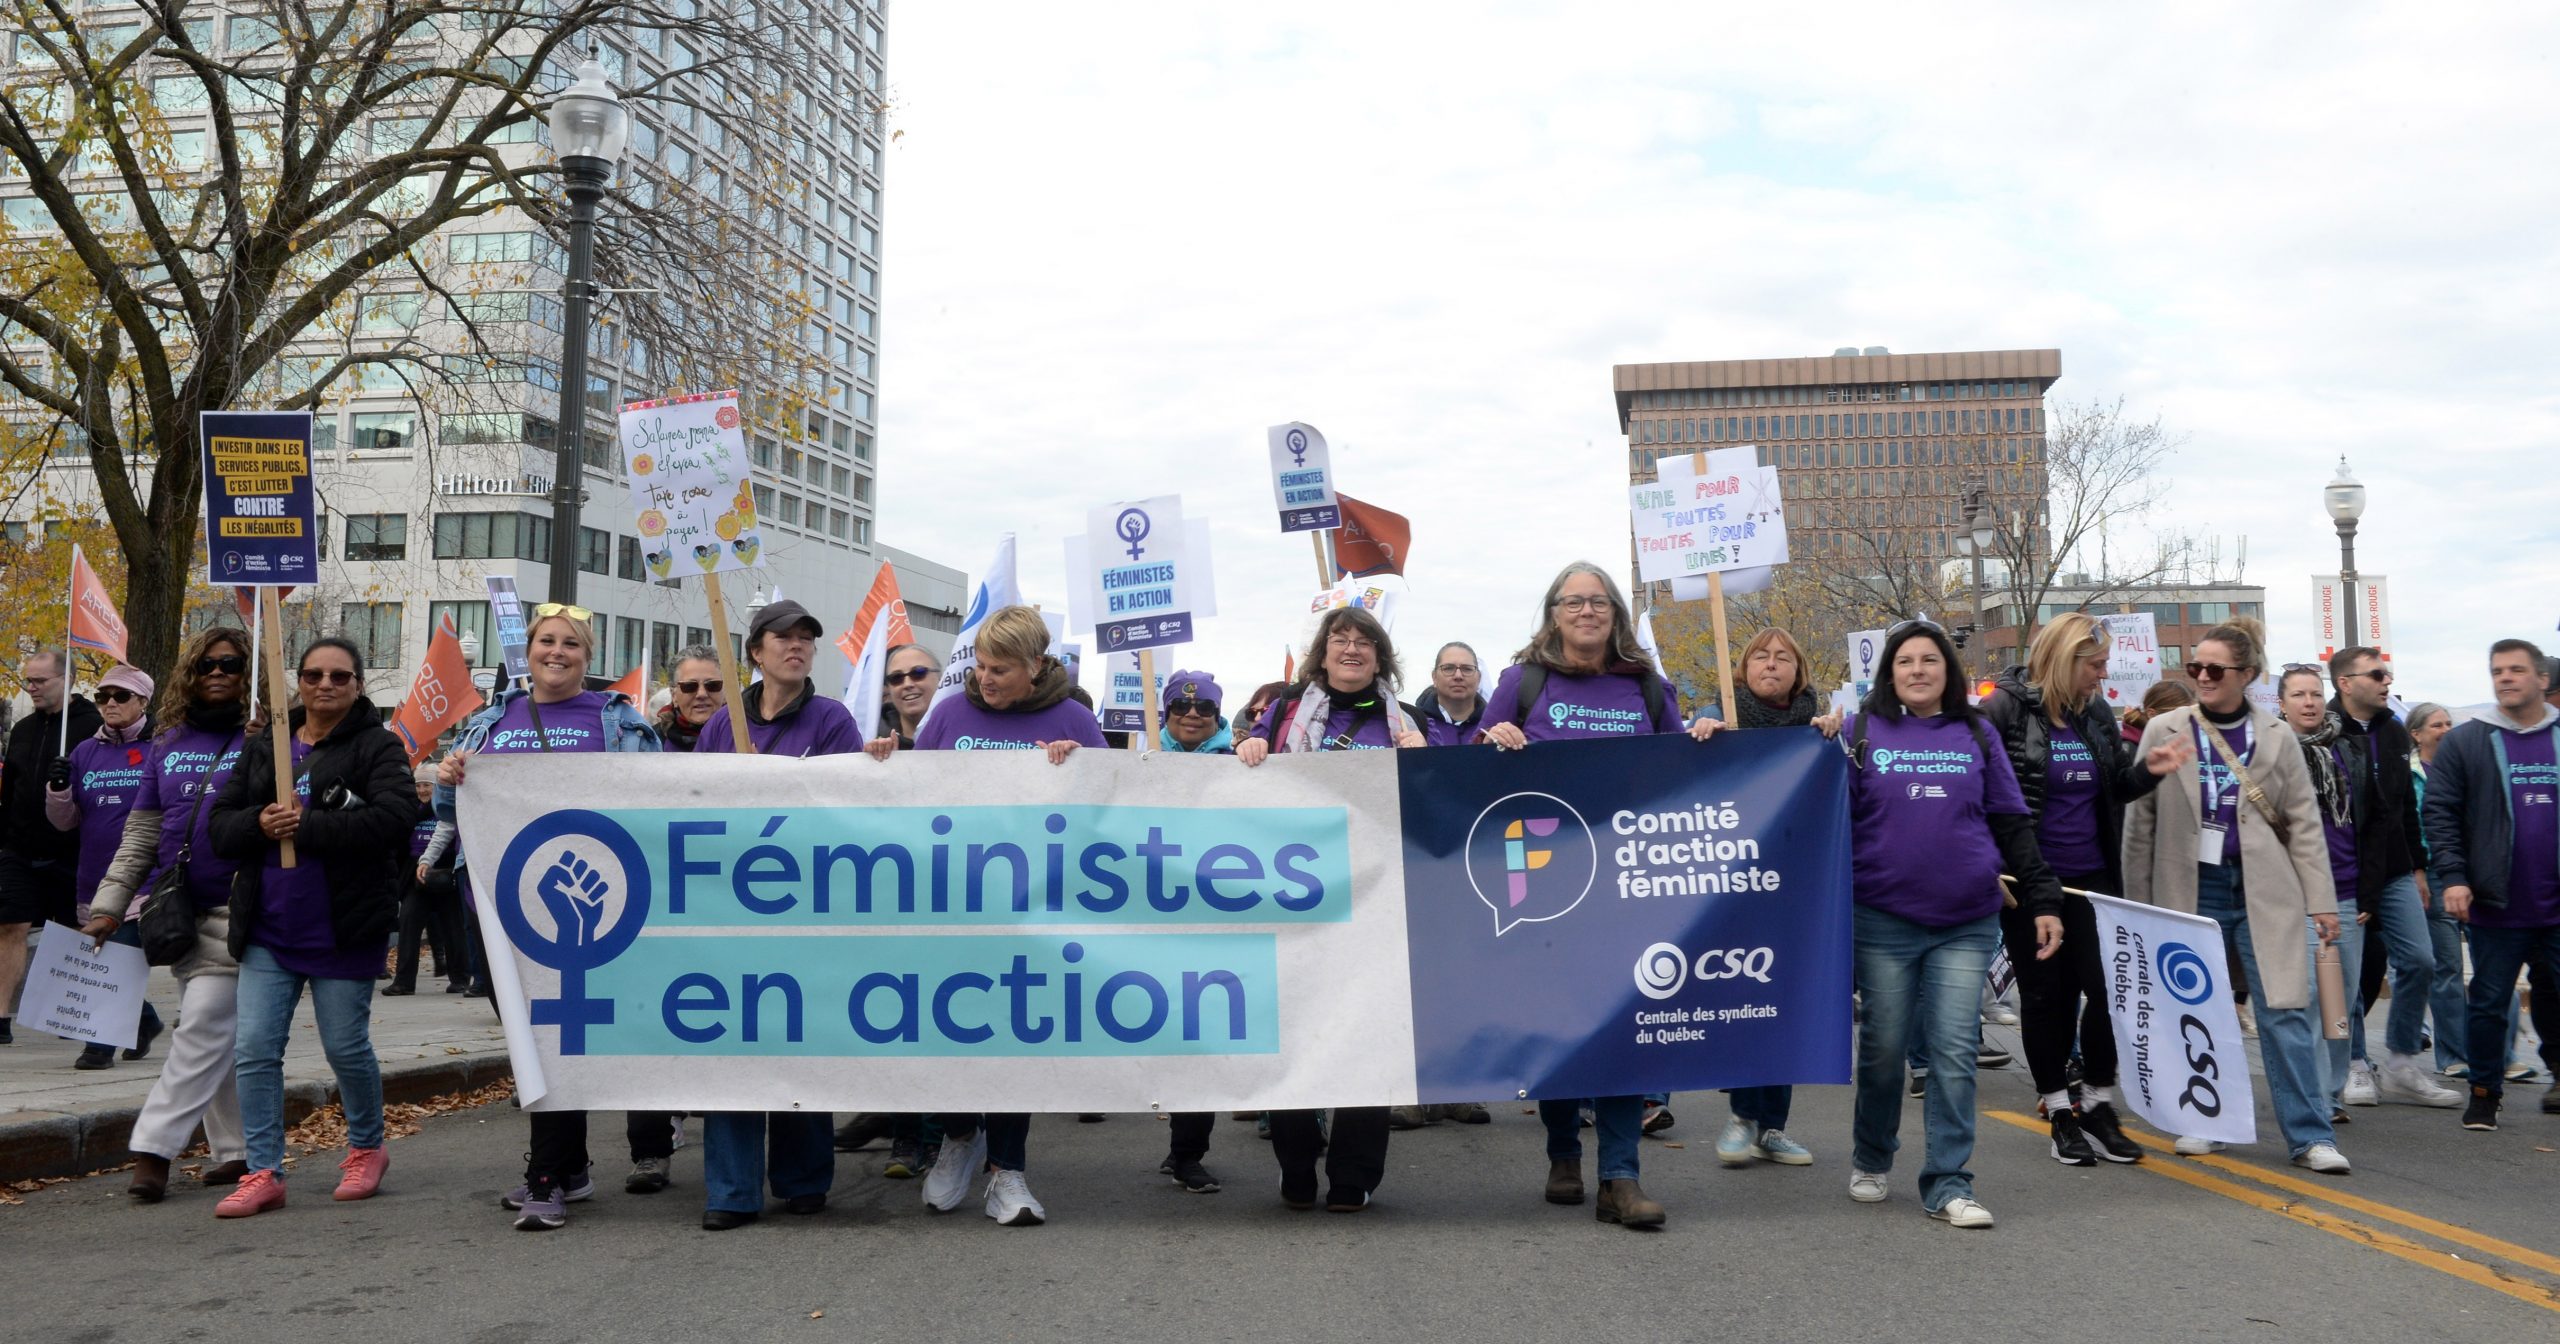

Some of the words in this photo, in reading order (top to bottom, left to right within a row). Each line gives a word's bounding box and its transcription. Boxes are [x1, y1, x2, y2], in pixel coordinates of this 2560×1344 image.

[215, 441, 253, 454] INVESTIR
[255, 442, 280, 455] DANS
[283, 443, 300, 455] LES
[219, 460, 259, 473] SERVICES
[262, 460, 304, 474] PUBLICS,
[230, 480, 252, 492] C'EST
[255, 479, 289, 491] LUTTER
[438, 472, 513, 494] Hilton
[527, 474, 554, 493] Hilt
[1696, 476, 1740, 499] POUR
[234, 497, 285, 516] CONTRE
[1662, 503, 1726, 528] TOUTES
[226, 522, 242, 534] LES
[244, 520, 296, 535] INÉGALITÉS
[1638, 532, 1695, 553] TOUTES
[1709, 521, 1756, 543] POUR
[1103, 565, 1174, 590] FÉMINISTES
[1109, 595, 1125, 612] EN
[1128, 589, 1172, 609] ACTION
[81, 588, 121, 634] AREQ
[2322, 585, 2334, 640] CROIX-ROUGE
[2368, 584, 2381, 639] CROIX-ROUGE
[2118, 635, 2155, 652] FALL
[1114, 674, 1163, 688] FÉMINIES
[418, 663, 448, 719] REQ
[1116, 692, 1126, 703] EN
[1569, 704, 1643, 721] Féministes
[1567, 720, 1586, 729] en
[1589, 721, 1635, 734] action
[508, 740, 528, 748] en
[532, 738, 578, 749] ation
[1893, 750, 1973, 762] Féministes
[2053, 753, 2068, 761] en
[2070, 751, 2093, 761] acti
[95, 768, 145, 778] Féministe
[175, 764, 192, 773] en
[1893, 763, 1913, 773] en
[1916, 762, 1967, 774] action
[106, 777, 140, 787] action
[1612, 801, 1740, 836] Comité
[1615, 833, 1760, 867] d'action
[668, 813, 1326, 915] Féministes
[1617, 864, 1781, 898] féministe
[2116, 925, 2130, 945] du
[1694, 947, 1775, 983] CSQ
[2132, 932, 2154, 995] Centrale
[79, 977, 101, 989] rente
[102, 981, 118, 992] Une
[2113, 951, 2132, 1012] Québec
[661, 972, 803, 1043] en
[847, 942, 1247, 1046] action
[1635, 1008, 1689, 1025] Centrale
[1692, 1007, 1715, 1022] des
[1718, 1004, 1778, 1024] syndicats
[2137, 1001, 2155, 1029] des
[78, 1028, 97, 1037] Pour
[1636, 1029, 1653, 1044] du
[1656, 1027, 1706, 1045] Québec
[2178, 1013, 2221, 1118] CSQ
